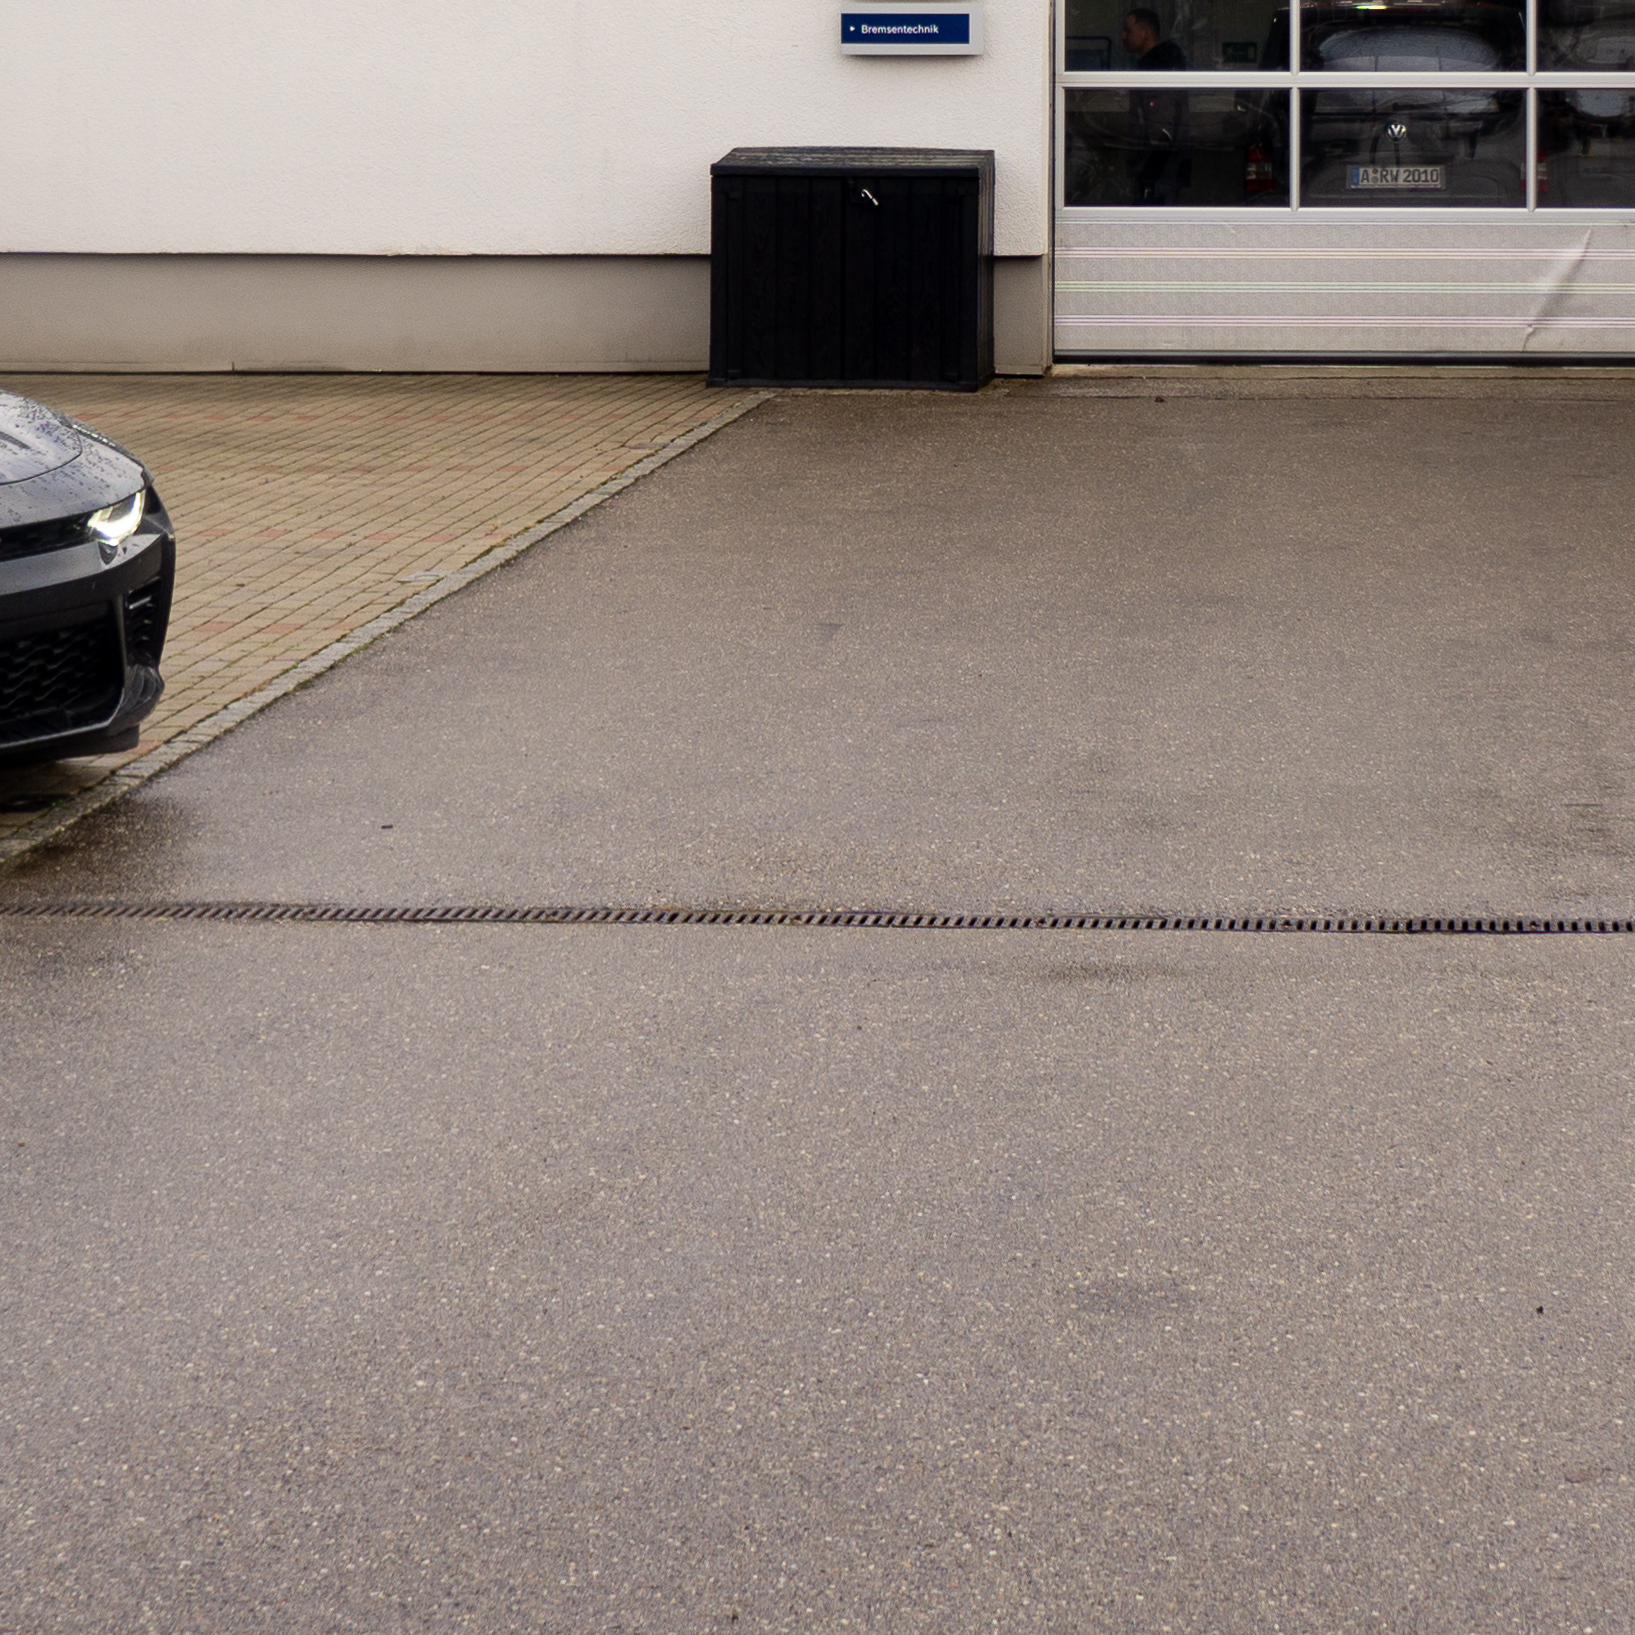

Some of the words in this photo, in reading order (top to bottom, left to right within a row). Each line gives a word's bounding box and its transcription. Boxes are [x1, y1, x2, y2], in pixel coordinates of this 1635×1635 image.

[861, 24, 939, 34] Bremsentechnik
[1360, 169, 1370, 184] A
[1379, 169, 1400, 184] RW
[1403, 169, 1439, 184] 2010
